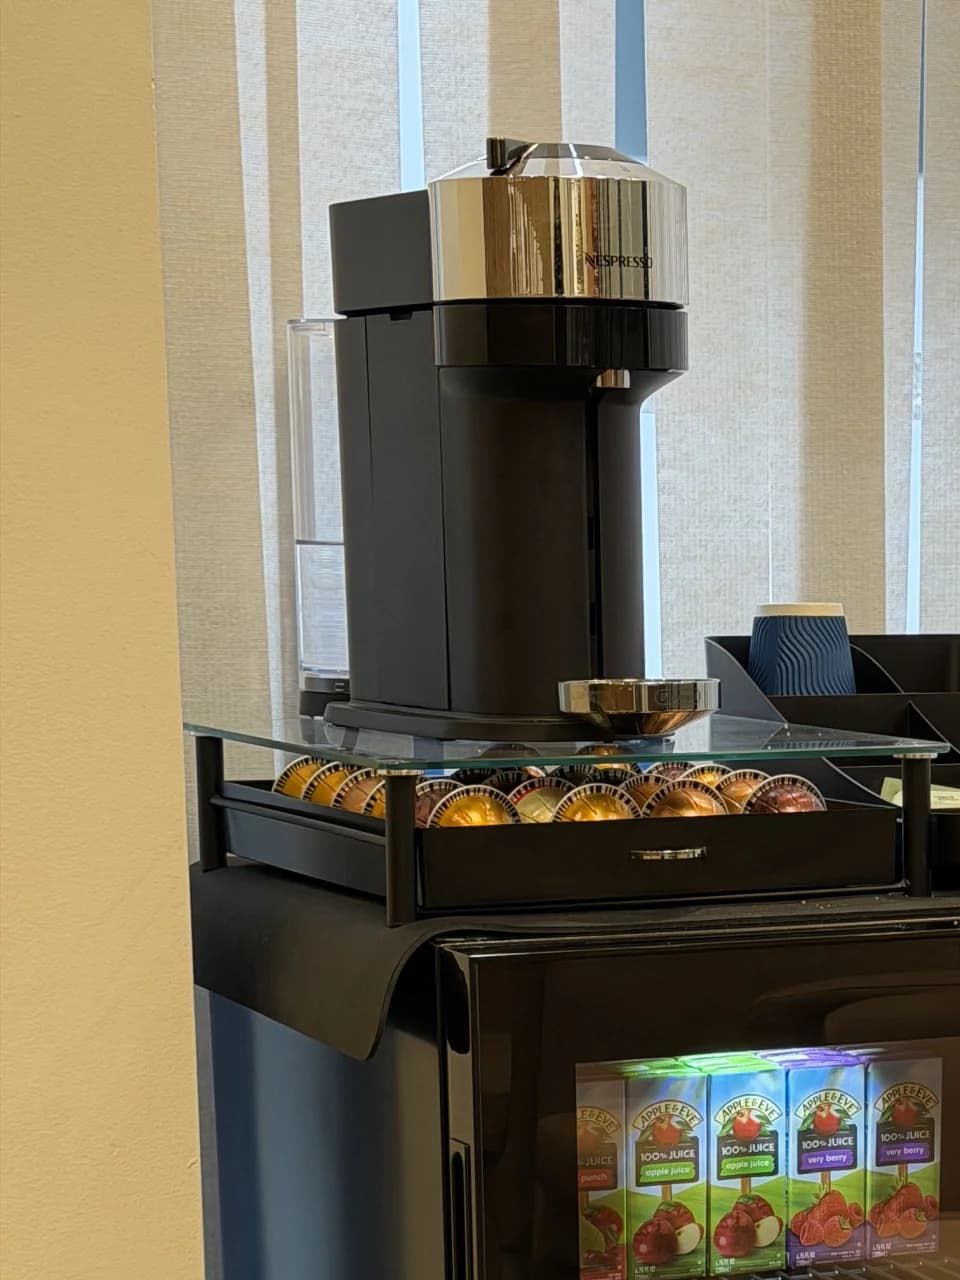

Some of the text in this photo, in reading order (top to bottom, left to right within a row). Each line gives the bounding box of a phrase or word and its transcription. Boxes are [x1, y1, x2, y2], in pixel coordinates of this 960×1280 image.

[582, 251, 653, 269] NESPRESSO
[802, 1136, 854, 1149] 100% JUICE
[881, 1130, 931, 1142] 100% JUICE
[641, 1149, 696, 1162] 100% JUICE
[721, 1143, 775, 1156] 100% JUICE
[886, 1146, 925, 1157] very berry
[726, 1158, 769, 1171] apple juice
[807, 1153, 848, 1165] very berry
[646, 1165, 690, 1178] apple juice
[581, 1173, 608, 1184] punch
